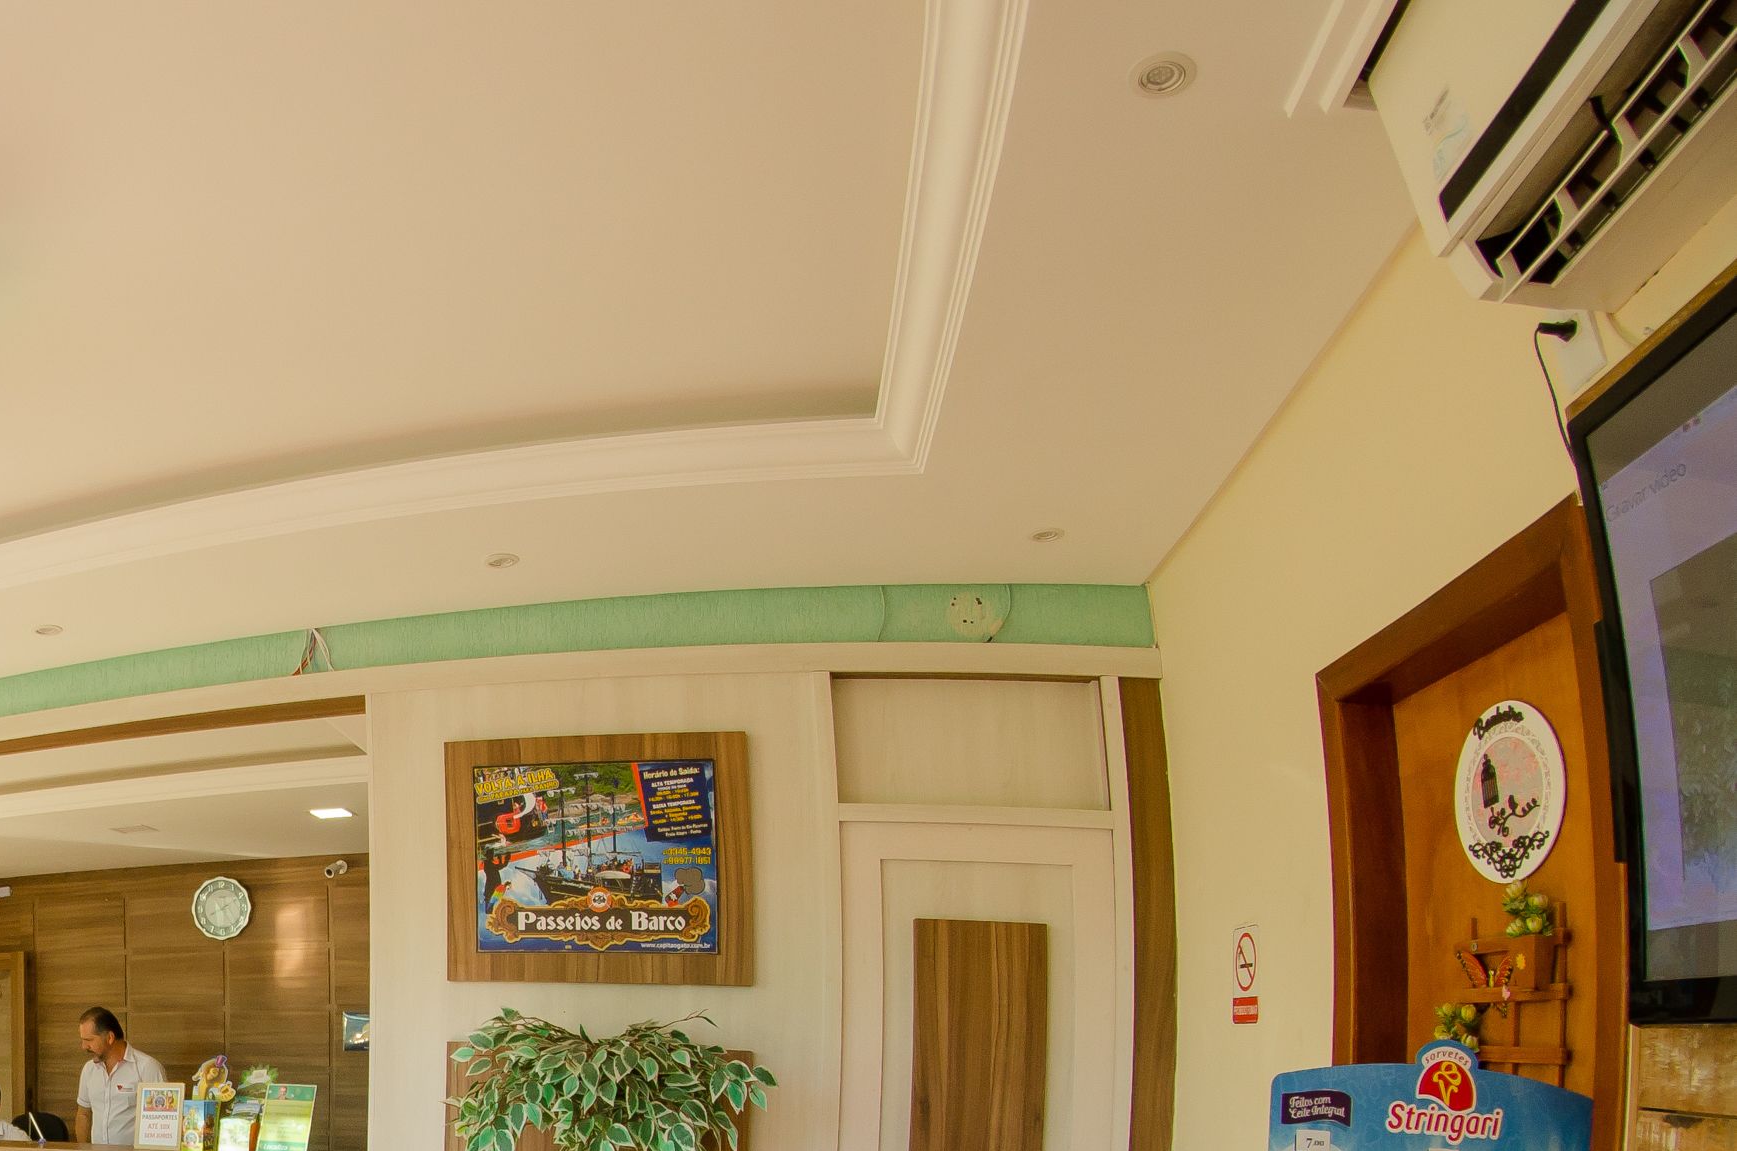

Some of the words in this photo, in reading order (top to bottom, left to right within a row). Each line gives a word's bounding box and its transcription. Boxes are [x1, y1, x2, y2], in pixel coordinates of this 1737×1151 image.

[475, 778, 512, 796] VOLTA
[517, 774, 525, 786] A
[527, 769, 554, 784] ILHA
[517, 911, 601, 931] Passeios
[605, 916, 623, 930] de
[630, 910, 686, 931] Barco
[1425, 1050, 1470, 1066] sorvetes
[1387, 1103, 1502, 1141] Stringari
